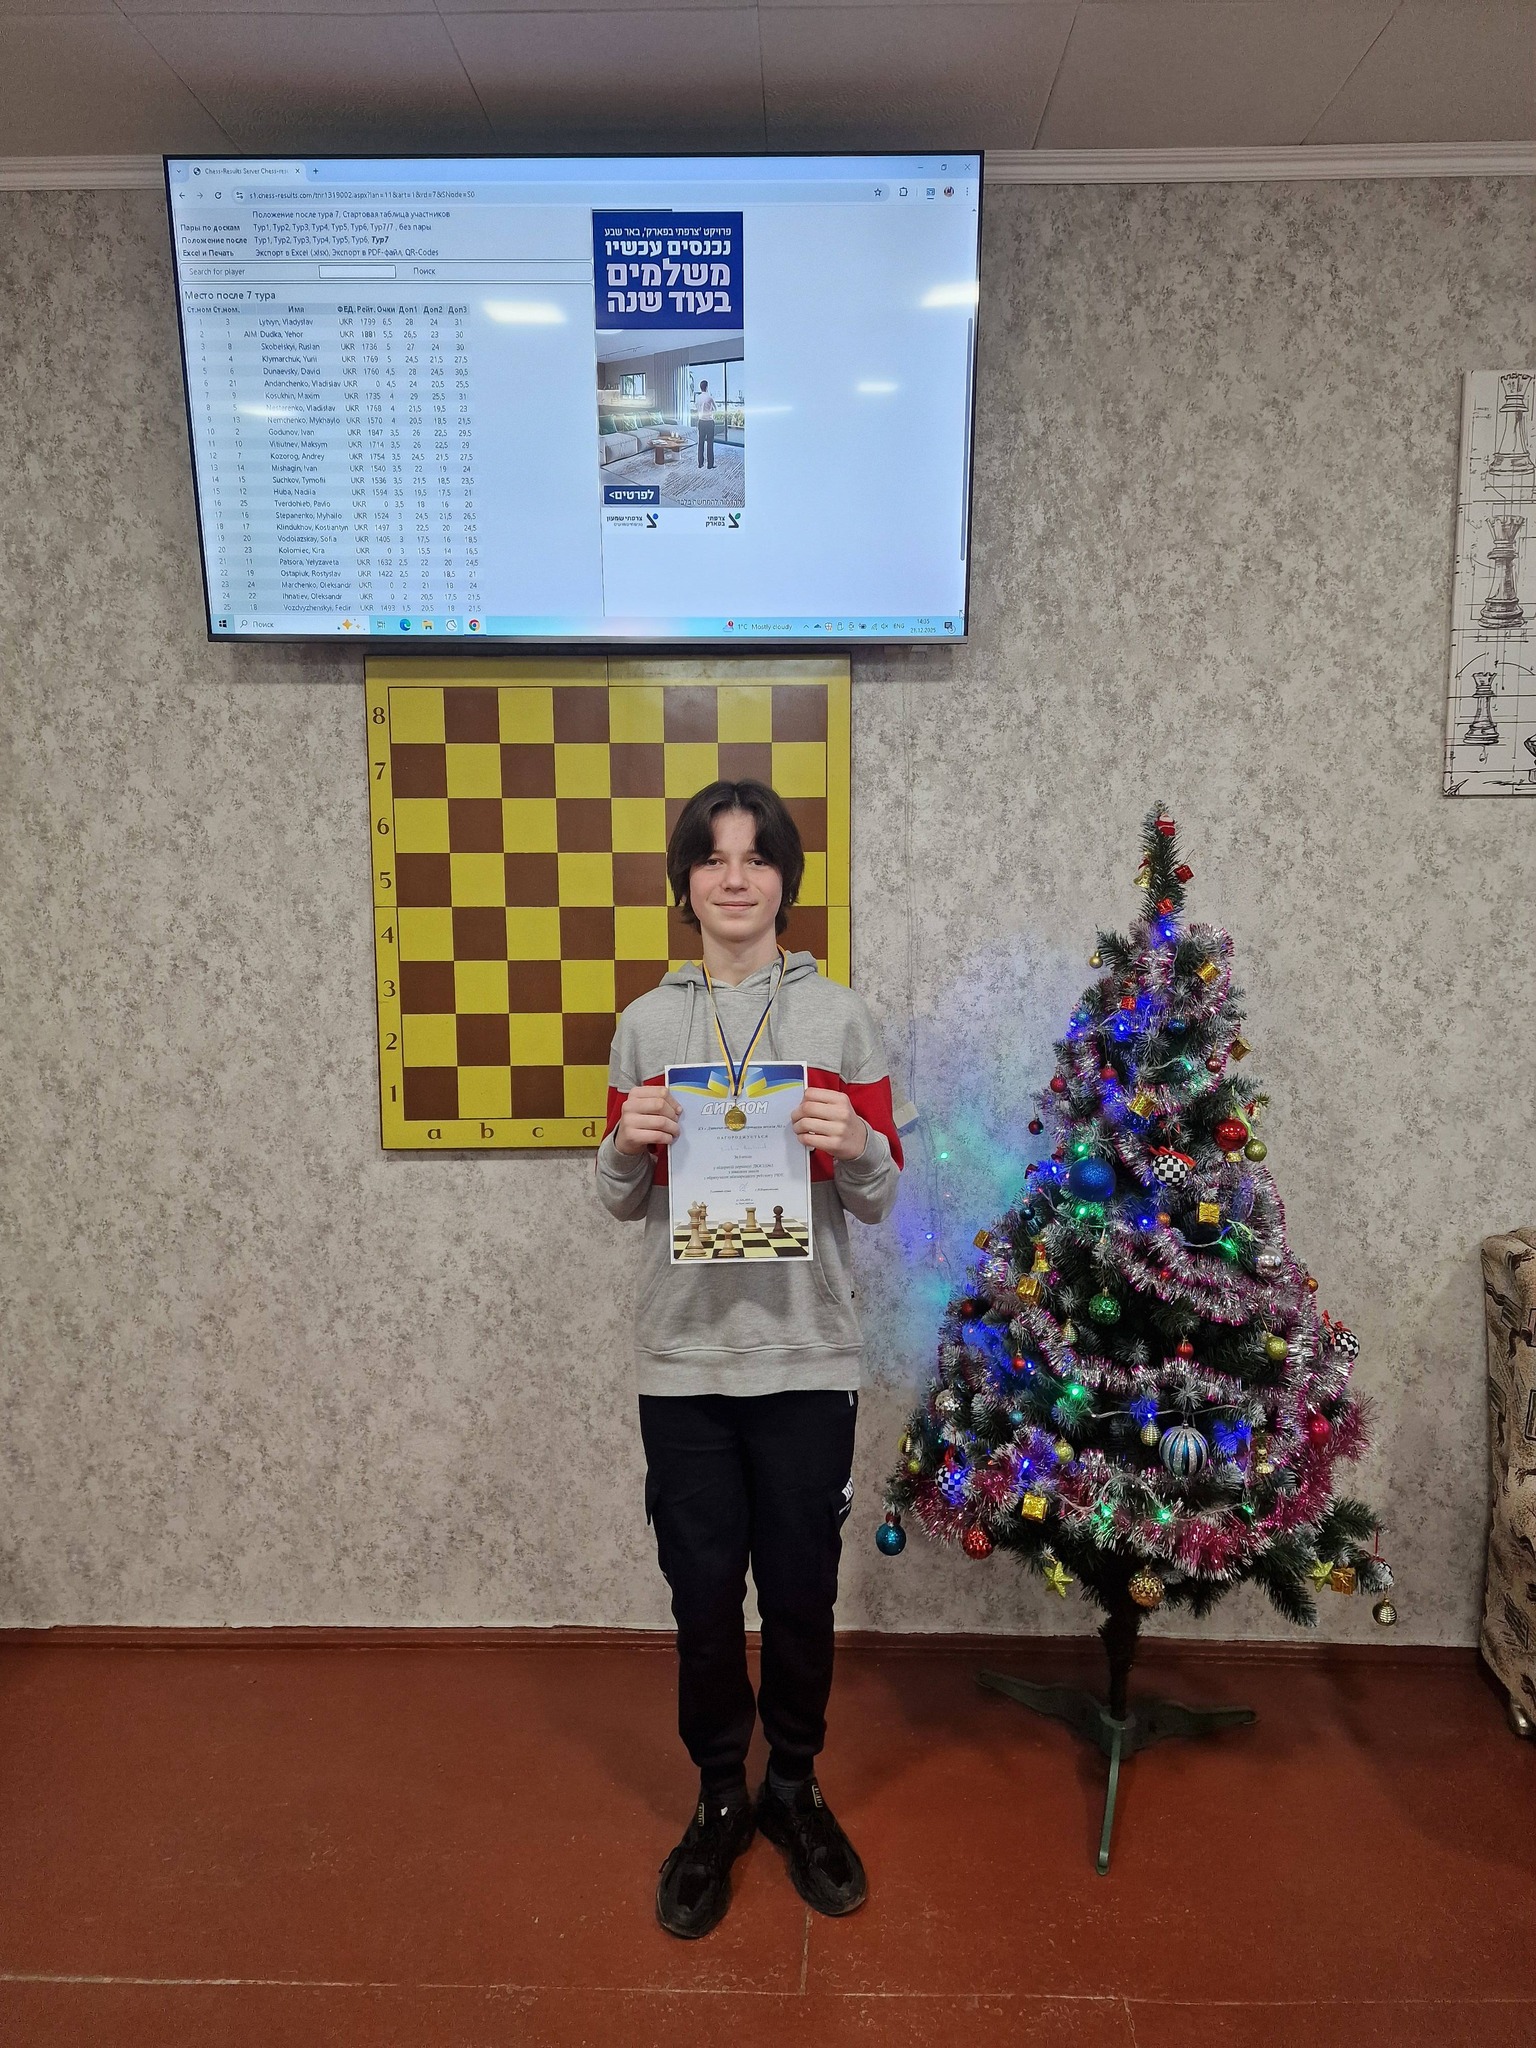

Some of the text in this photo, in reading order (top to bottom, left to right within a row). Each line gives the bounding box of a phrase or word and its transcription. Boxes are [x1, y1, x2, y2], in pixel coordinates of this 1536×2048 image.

[180, 224, 201, 232] Пары
[413, 224, 431, 232] пары
[604, 228, 622, 237] שבע
[624, 228, 640, 236] באר
[703, 227, 731, 238] פרויקט
[182, 237, 224, 245] Положение
[372, 236, 389, 244] Тур7
[605, 240, 731, 257] נכנסים עכשיו
[208, 249, 234, 257] Печать
[256, 249, 283, 258] Экспорт
[332, 249, 360, 257] Экспорт
[405, 249, 438, 257] QR-Codes
[225, 268, 245, 277] player
[414, 267, 435, 275] Поиск
[606, 257, 730, 287] משלמים
[185, 291, 214, 300] Место
[247, 291, 251, 299] 7
[255, 292, 276, 302] тура
[607, 291, 732, 315] בעוד שנה
[399, 306, 418, 314] Доп1
[423, 306, 442, 314] Доп2
[448, 306, 467, 314] Доп3
[282, 318, 313, 327] Vladyslav
[260, 331, 283, 339] Dudka,
[263, 368, 300, 376] Dunaevsky,
[431, 368, 444, 376] 24,5
[455, 368, 468, 376] 30,5
[271, 453, 300, 461] Kozorog,
[301, 453, 324, 461] Andrey
[272, 464, 302, 472] Mishagin,
[306, 558, 339, 566] Yelyzaveta
[751, 623, 771, 632] Mostly
[772, 623, 793, 632] cloudy
[372, 706, 386, 724] 8
[374, 762, 386, 780] 7
[377, 817, 389, 835] 6
[379, 872, 392, 889] 5
[381, 926, 394, 944] 4
[383, 980, 396, 997] 3
[385, 1033, 398, 1050] 2
[390, 1084, 397, 1102] 1
[427, 1121, 596, 1140] a b c d
